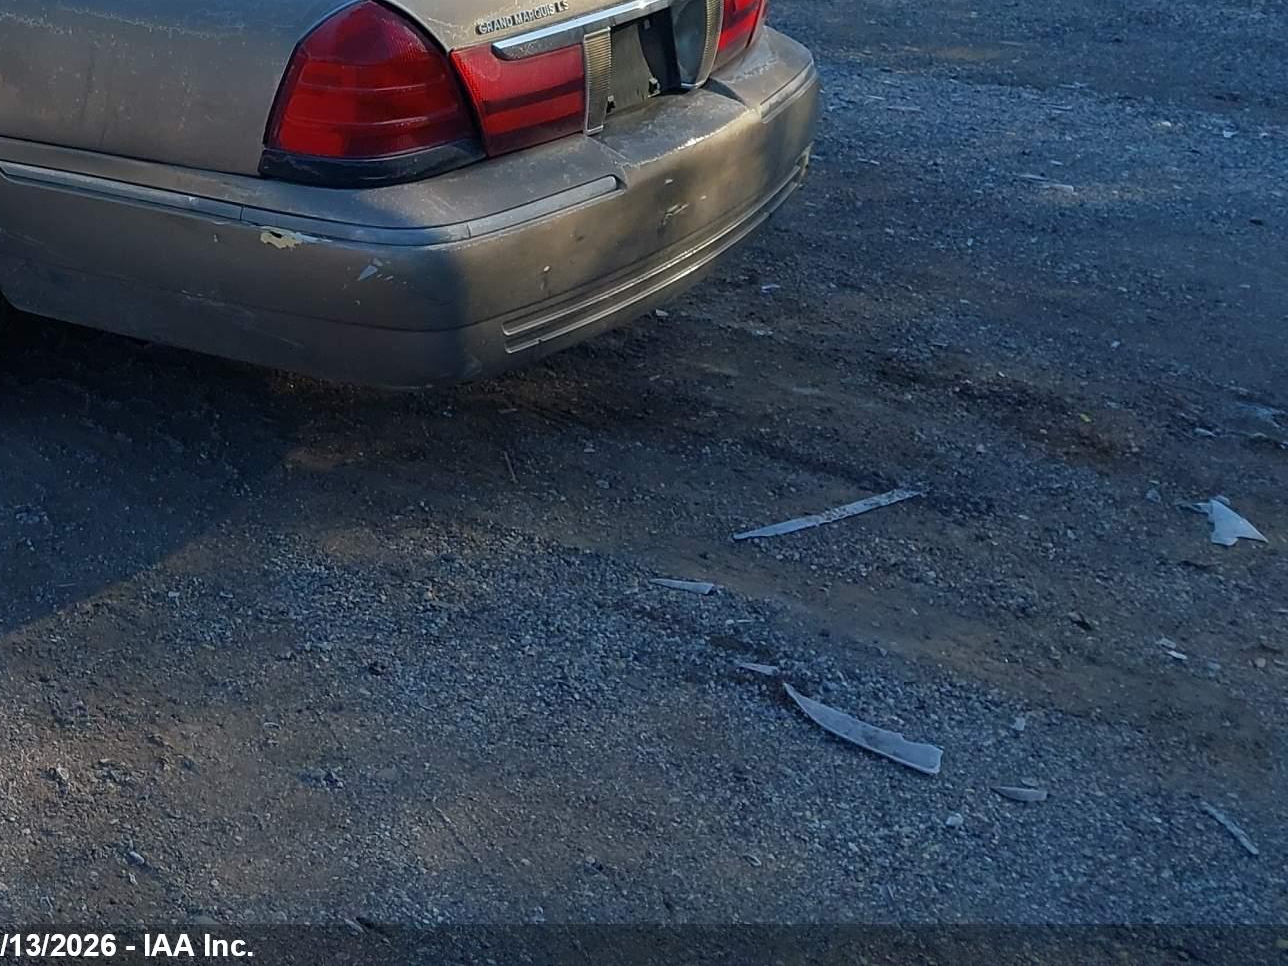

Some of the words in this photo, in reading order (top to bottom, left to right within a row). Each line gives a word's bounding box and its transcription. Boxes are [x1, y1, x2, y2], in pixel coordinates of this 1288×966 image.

[475, 16, 514, 35] GRAND
[513, 4, 555, 26] MARQUIS
[554, 0, 569, 13] LS
